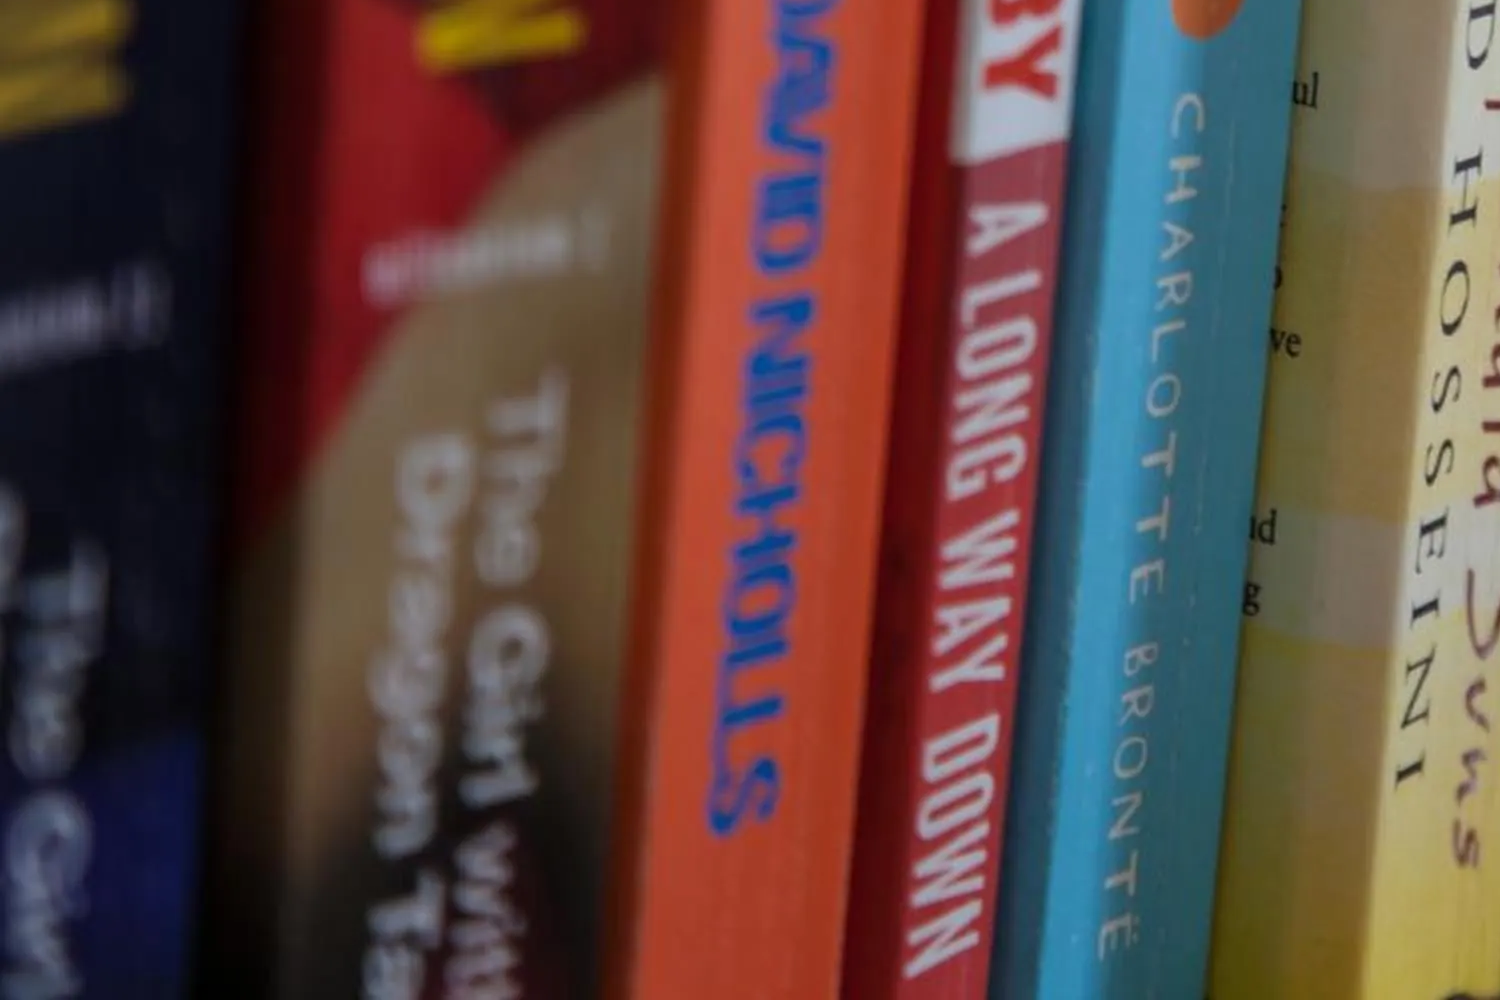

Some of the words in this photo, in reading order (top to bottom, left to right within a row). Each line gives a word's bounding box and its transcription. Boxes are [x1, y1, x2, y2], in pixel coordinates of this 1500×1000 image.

[966, 201, 1048, 258] A
[1129, 90, 1208, 605] CHARLOTTE
[484, 360, 570, 588] The
[942, 269, 1045, 502] LONG
[1393, 149, 1482, 793] HOSSEINI
[366, 430, 474, 860] Dragon
[707, 290, 818, 839] NICHOLLS
[930, 508, 1022, 694] WAY
[456, 602, 553, 808] Girl
[1097, 640, 1160, 961] BRONTË
[902, 710, 999, 980] DOWN
